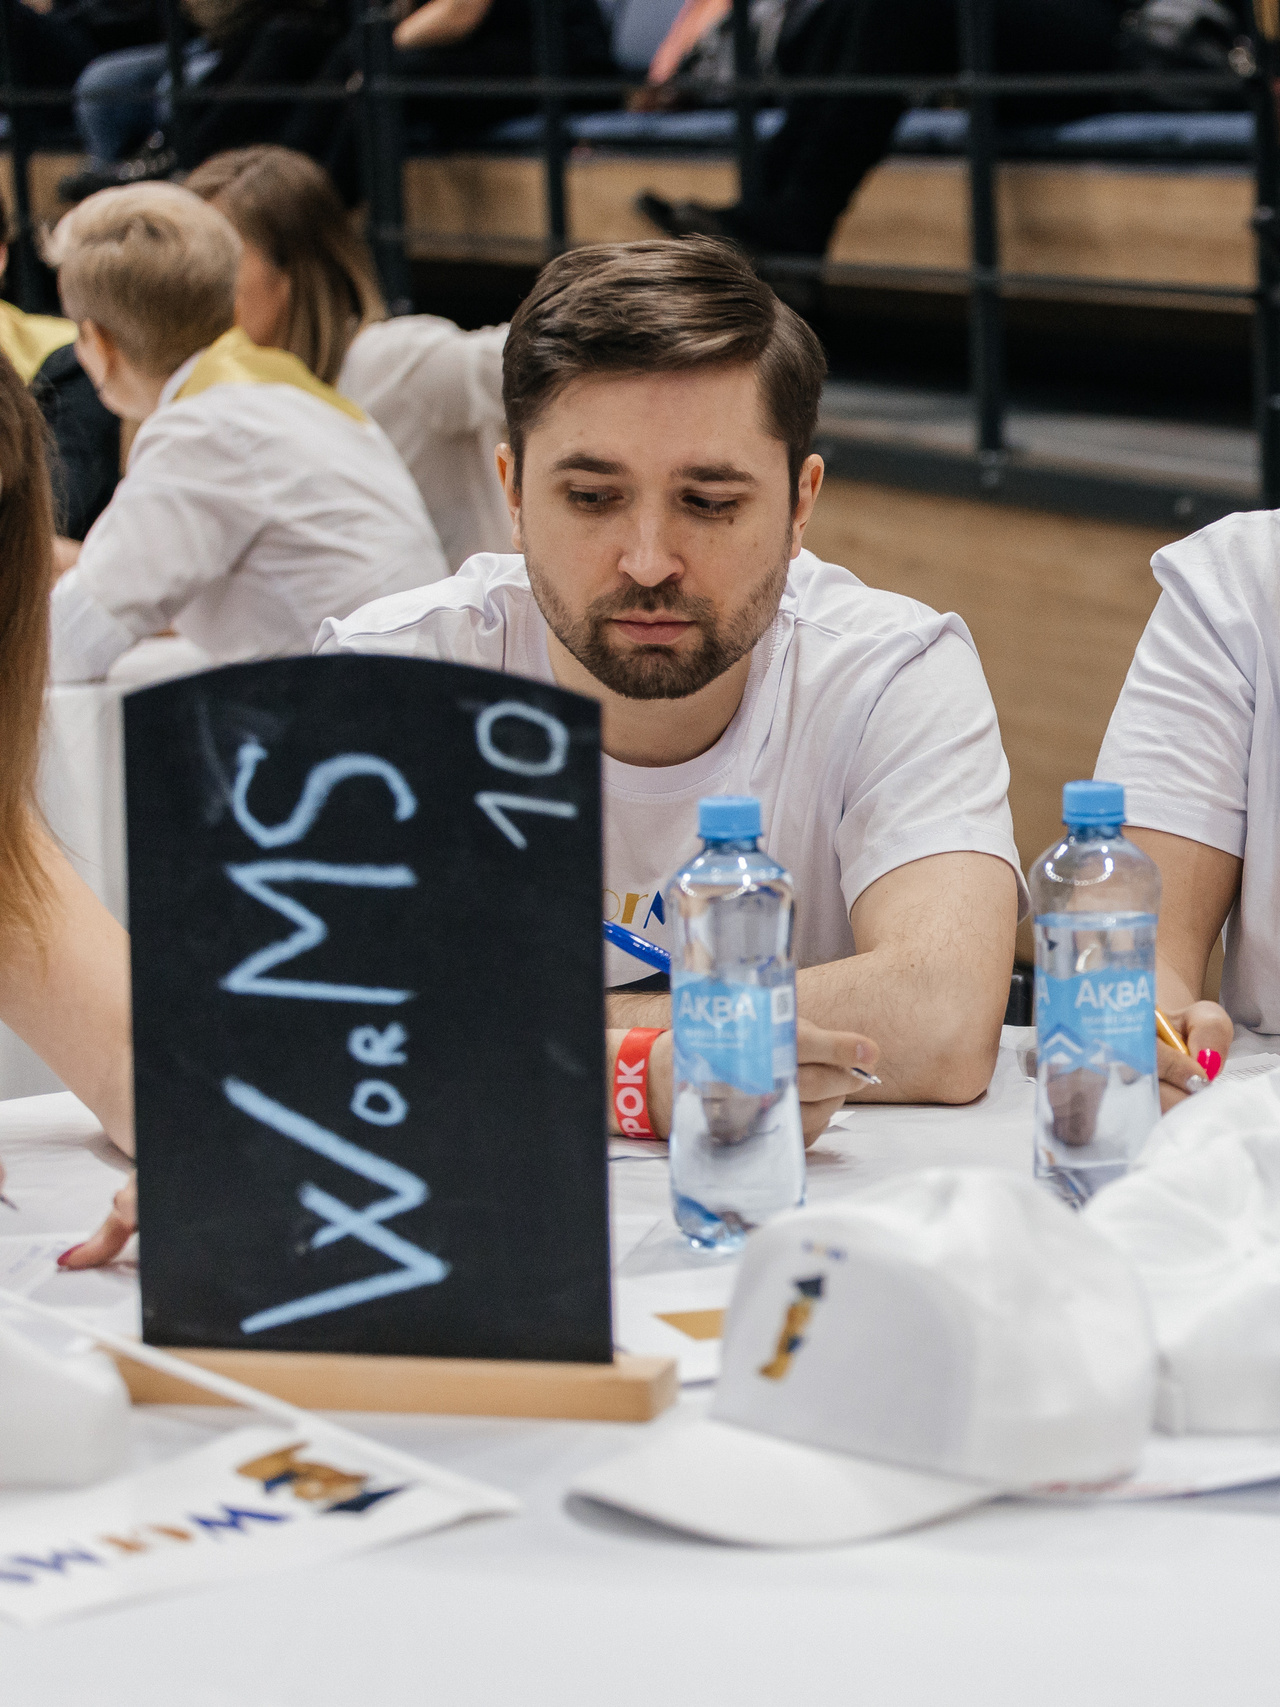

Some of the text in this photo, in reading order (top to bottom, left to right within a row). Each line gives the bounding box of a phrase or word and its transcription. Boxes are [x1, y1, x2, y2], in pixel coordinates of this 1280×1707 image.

[475, 699, 579, 849] 10
[678, 990, 758, 1029] АКВА
[1074, 975, 1151, 1012] АКВА
[615, 1058, 651, 1138] РОК
